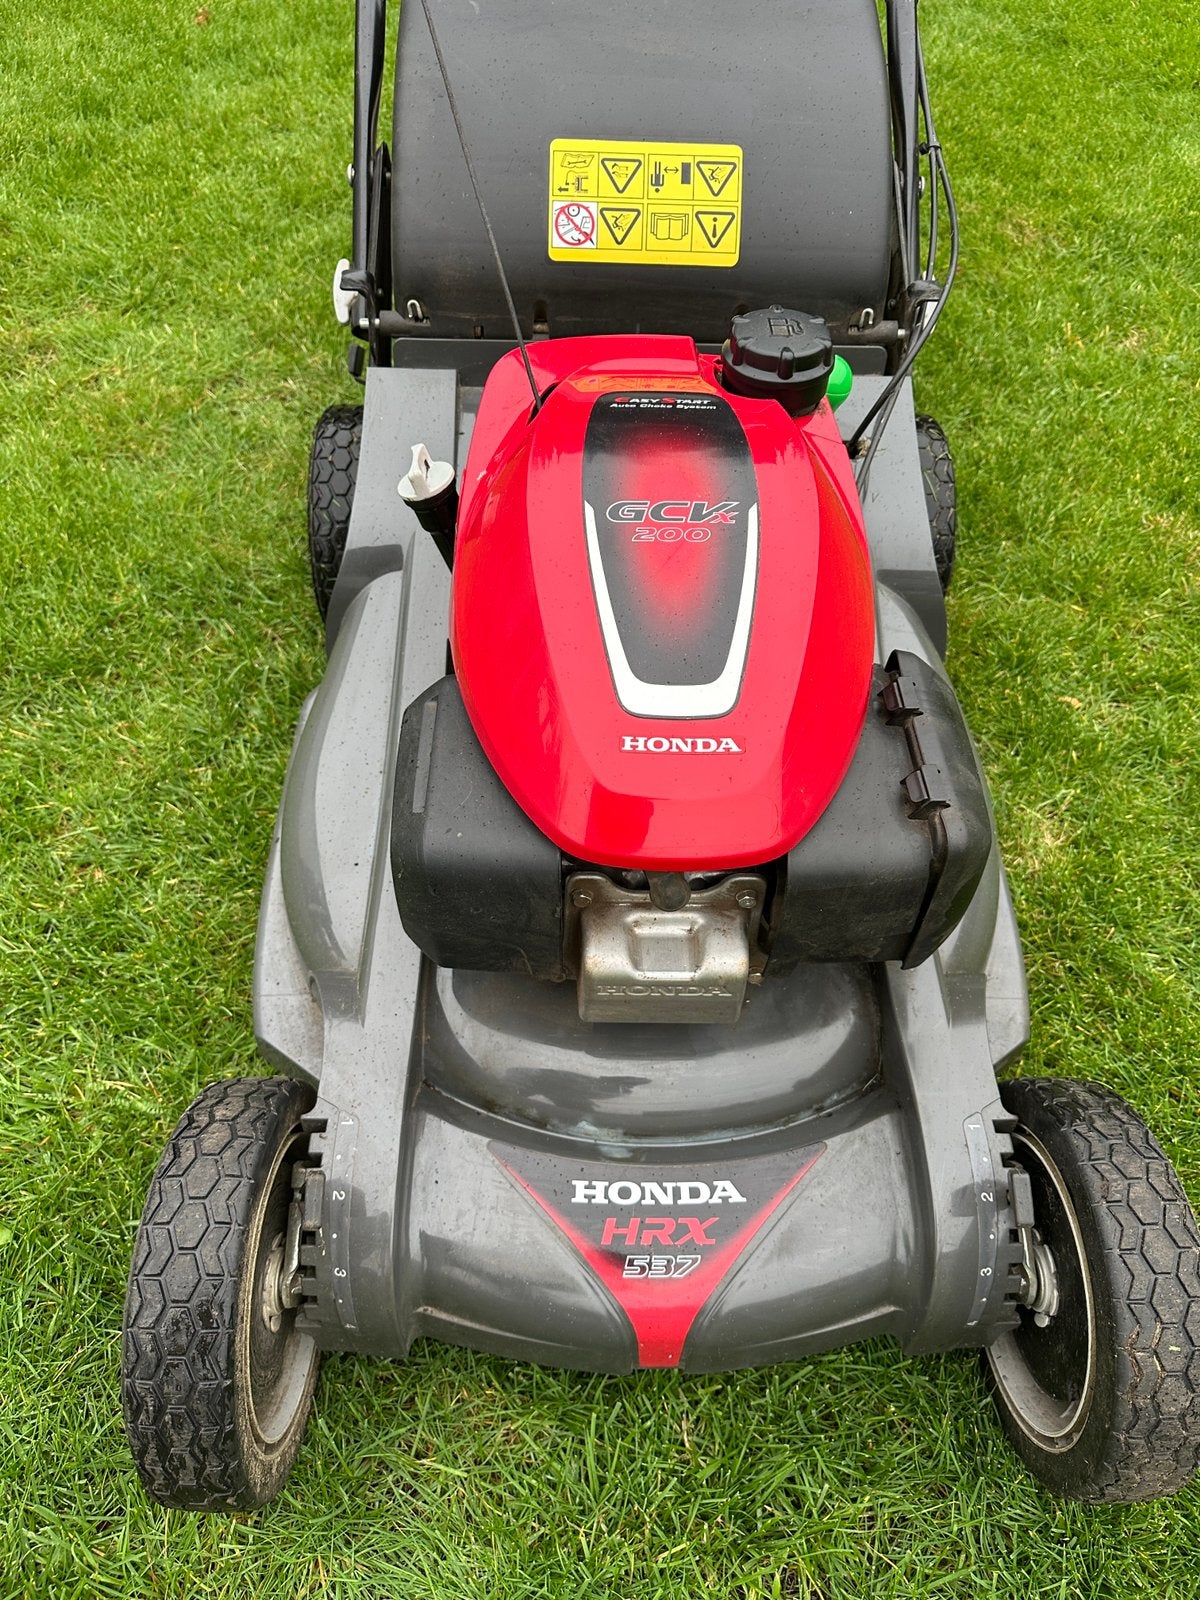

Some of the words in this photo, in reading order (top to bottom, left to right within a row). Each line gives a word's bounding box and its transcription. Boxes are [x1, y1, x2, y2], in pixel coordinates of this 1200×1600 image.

[632, 527, 711, 542] 200
[621, 736, 742, 753] HONDA
[597, 985, 733, 997] HONDA
[332, 1190, 346, 1201] 2
[571, 1180, 747, 1205] HONDA
[981, 1191, 994, 1202] 2
[600, 1217, 720, 1246] HRX
[334, 1267, 347, 1278] 3
[622, 1255, 702, 1279] 537
[980, 1267, 992, 1277] 3
